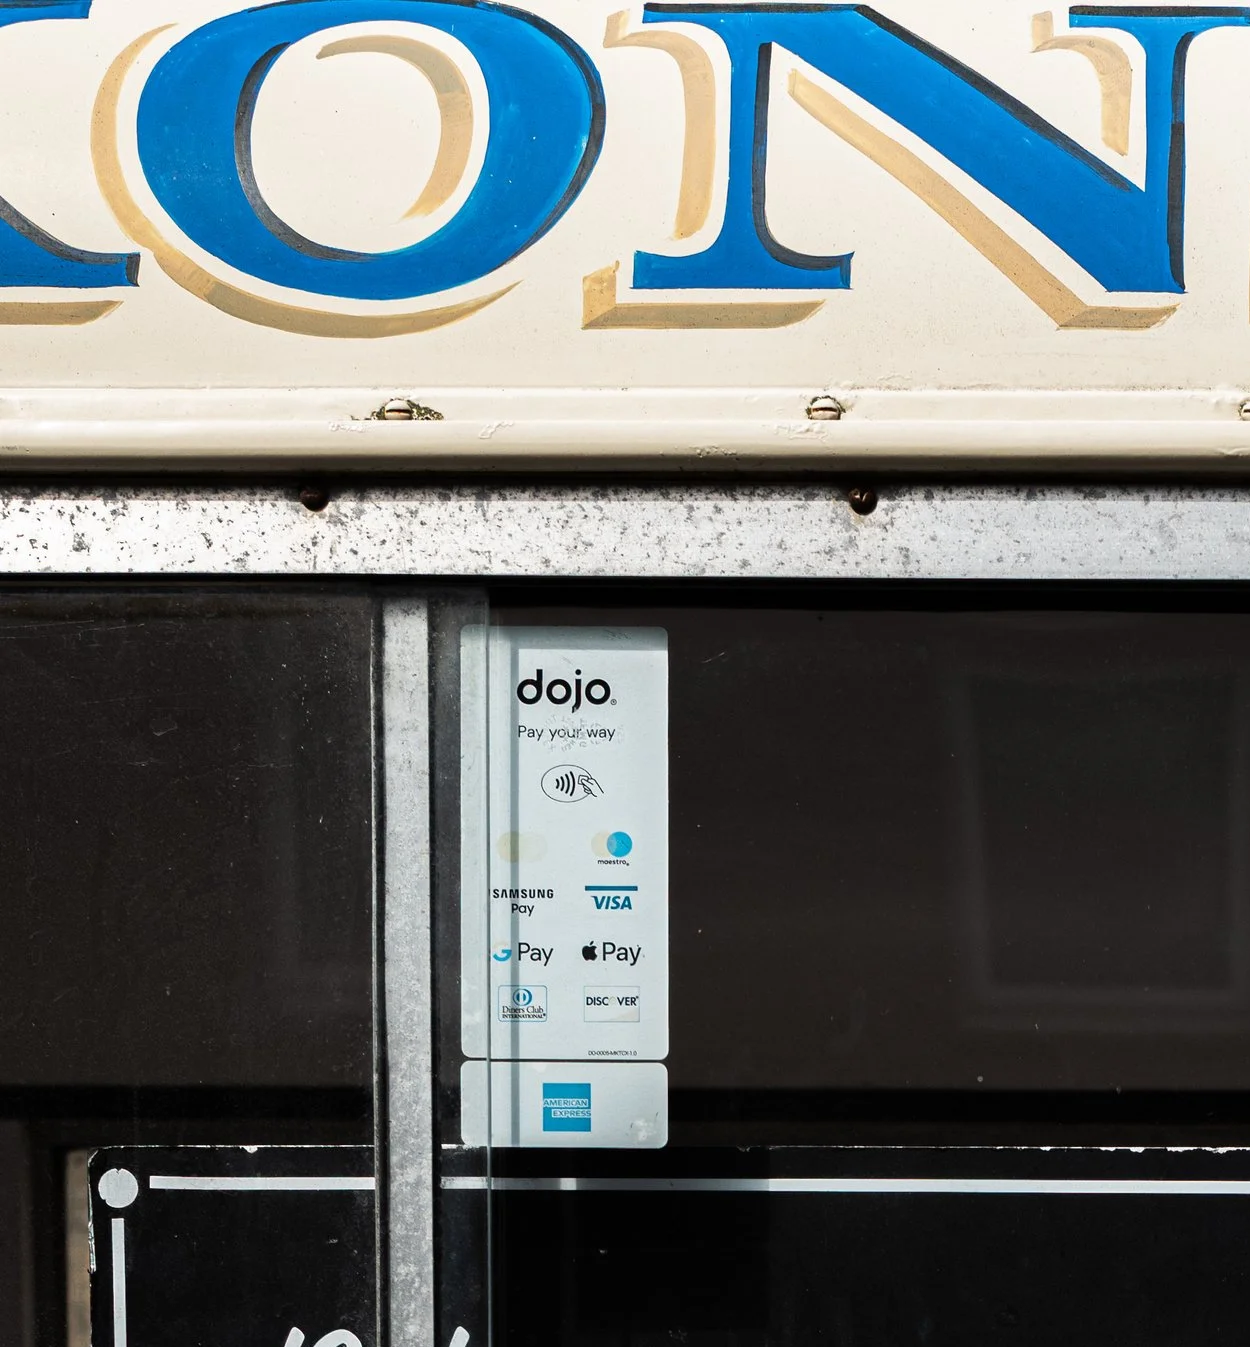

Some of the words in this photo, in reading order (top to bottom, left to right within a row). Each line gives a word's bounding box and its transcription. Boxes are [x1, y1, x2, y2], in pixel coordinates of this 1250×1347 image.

[518, 725, 544, 742] Pay
[549, 728, 582, 742] your
[587, 728, 616, 742] way
[492, 888, 554, 899] SAMSUNG
[591, 895, 633, 910] VISA
[511, 902, 535, 917] Pay
[518, 942, 554, 967] Pay
[602, 941, 642, 967] Pay
[586, 995, 639, 1007] DISCVER
[502, 1004, 526, 1015] Diners
[526, 1004, 544, 1014] Club
[543, 1099, 588, 1107] AMERICAN
[552, 1109, 592, 1118] EXPRESS
